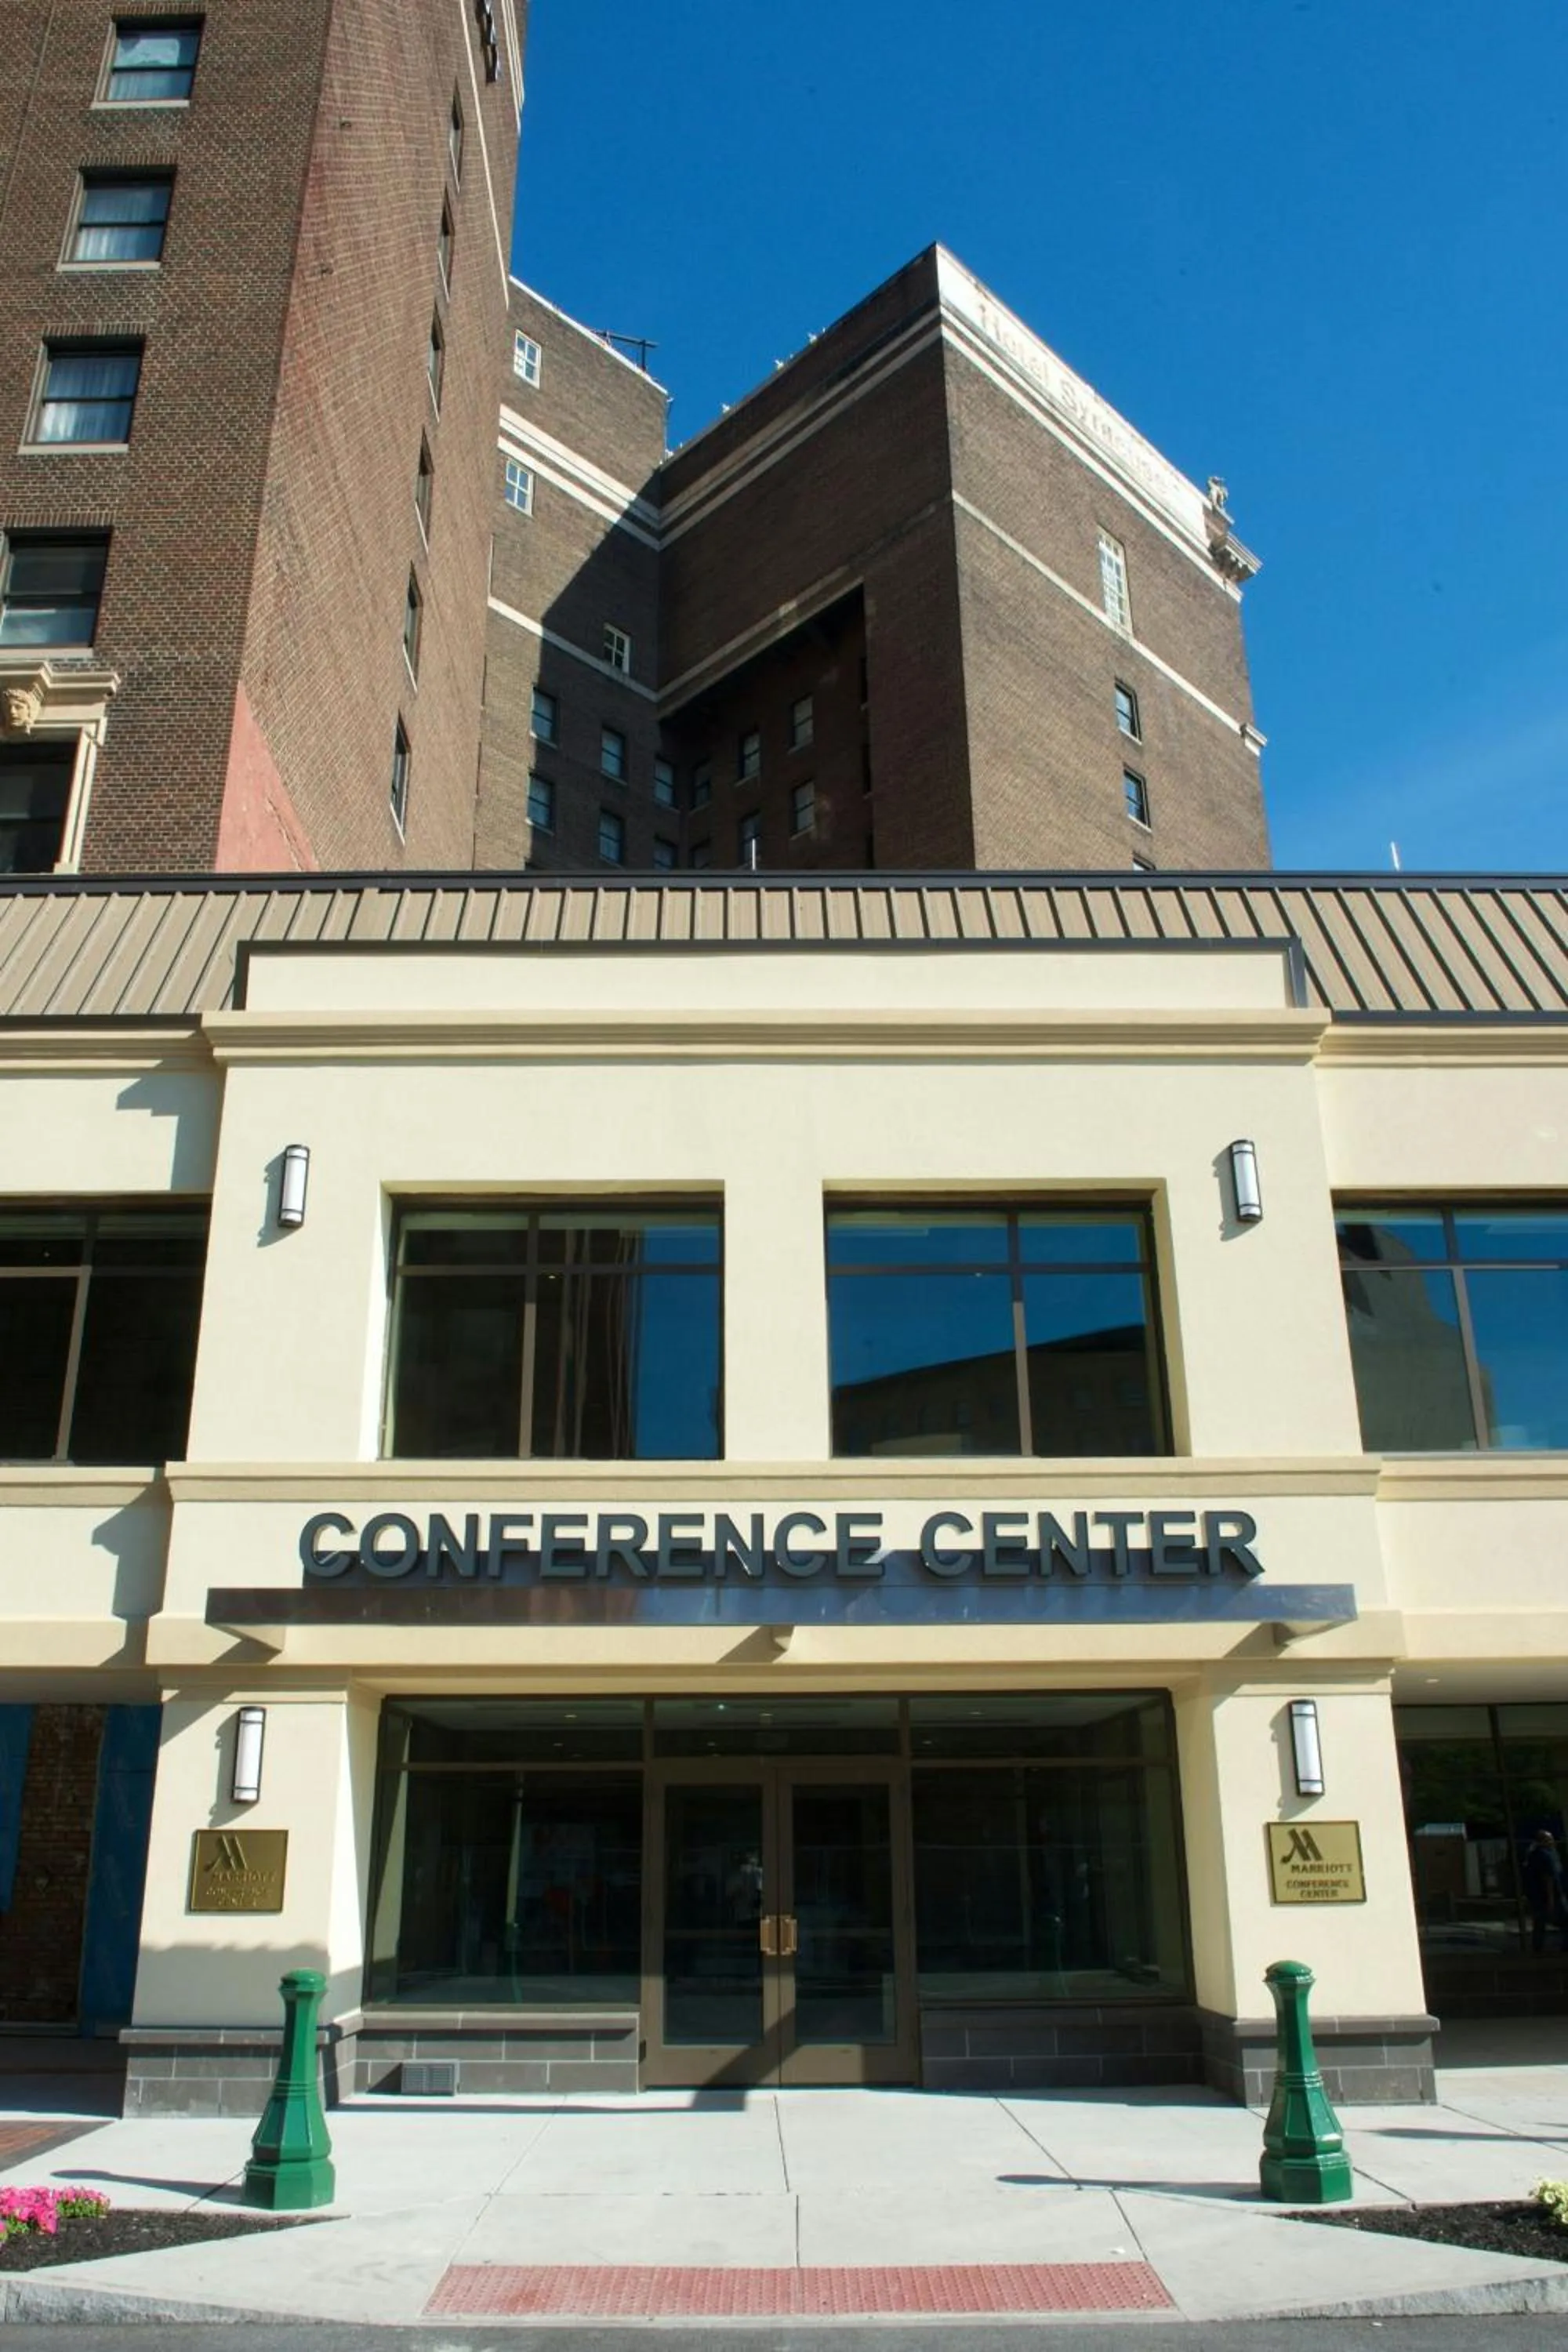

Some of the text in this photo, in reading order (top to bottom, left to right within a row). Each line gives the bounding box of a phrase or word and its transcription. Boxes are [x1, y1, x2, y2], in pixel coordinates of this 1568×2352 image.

[299, 1510, 1265, 1578] CONFERENCE CENTER
[1291, 1863, 1352, 1874] MARRIOTT
